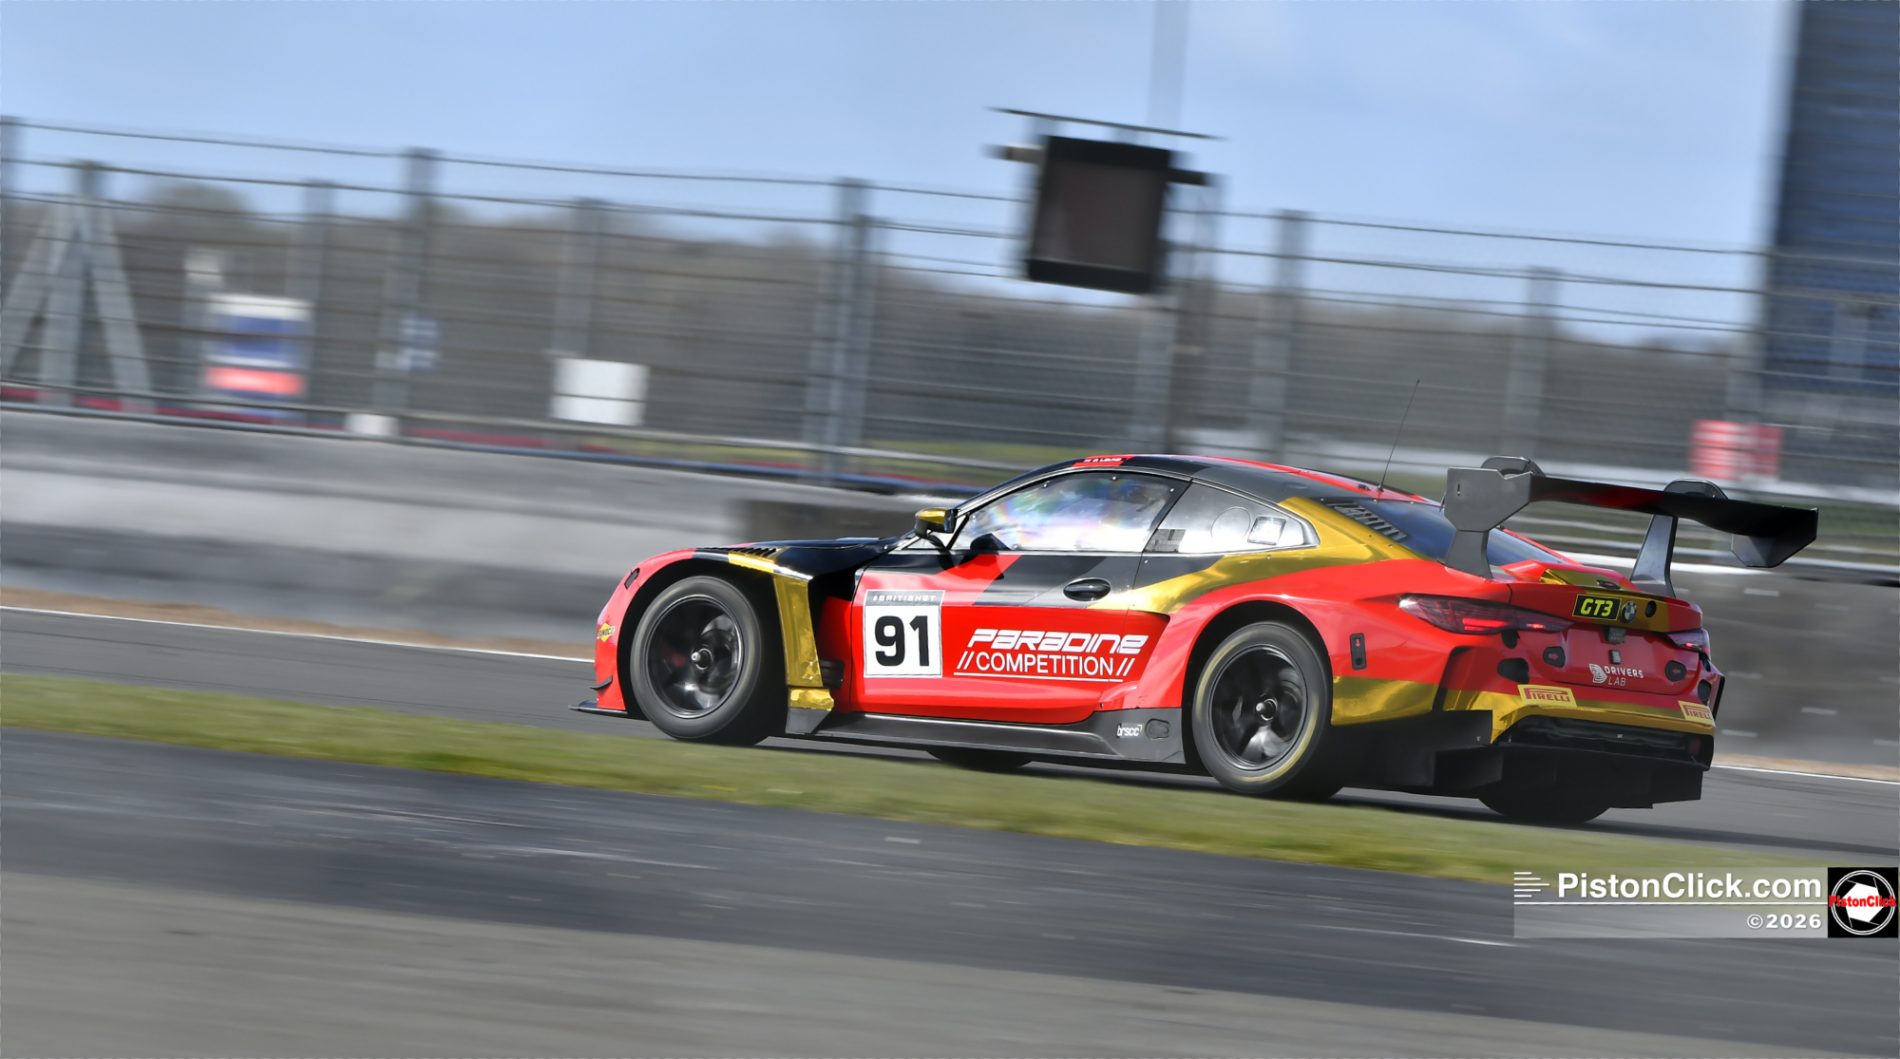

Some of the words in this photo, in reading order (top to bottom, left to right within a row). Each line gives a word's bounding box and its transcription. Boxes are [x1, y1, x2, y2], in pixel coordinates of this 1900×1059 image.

[1580, 598, 1614, 617] GT3
[874, 615, 930, 667] 91
[1604, 665, 1644, 678] DRIVERS
[1608, 676, 1626, 687] LAB
[1523, 688, 1571, 702] PIRELLI
